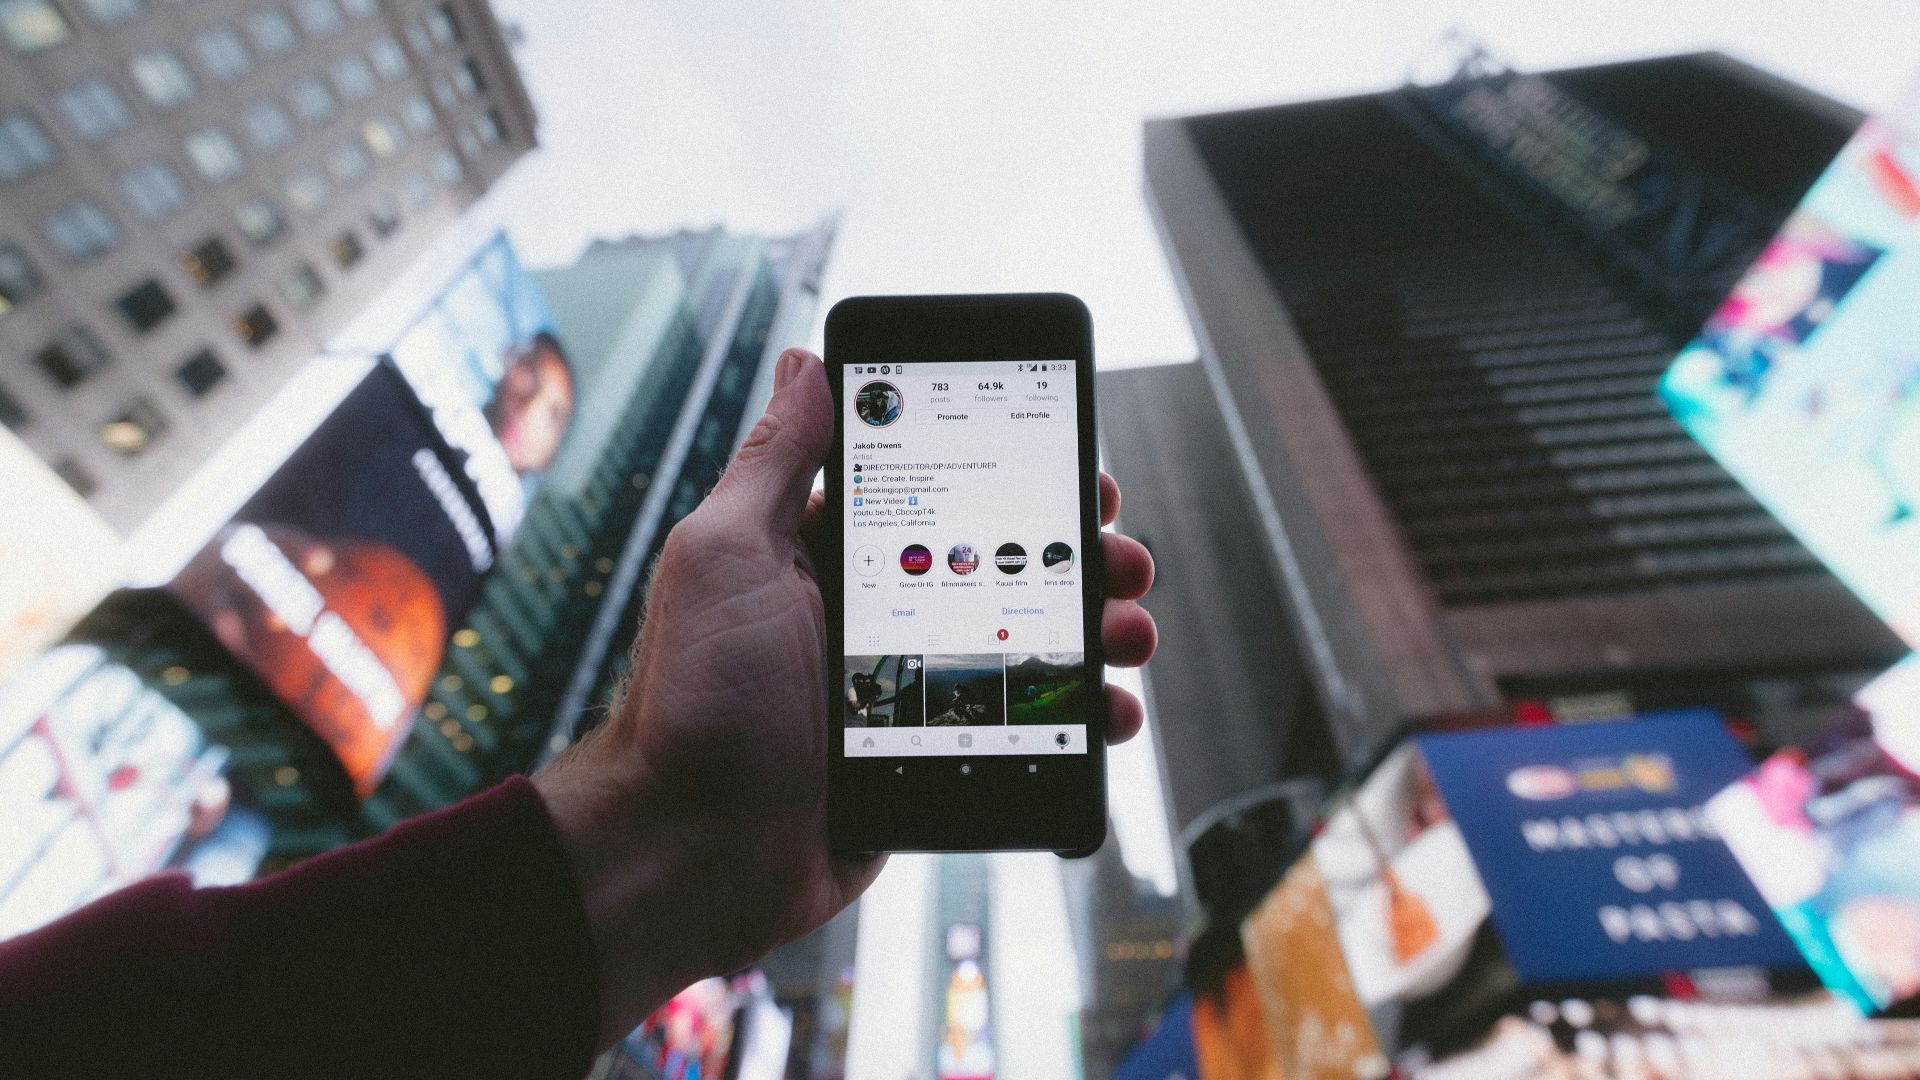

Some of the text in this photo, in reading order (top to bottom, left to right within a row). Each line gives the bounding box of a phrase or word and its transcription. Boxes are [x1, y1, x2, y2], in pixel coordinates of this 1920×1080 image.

[1051, 364, 1067, 372] 3:33
[931, 383, 949, 391] 783
[978, 382, 1004, 391] 64.9k
[1036, 381, 1048, 390] 19
[930, 395, 951, 403] posts
[974, 394, 1008, 402] followers
[1026, 394, 1058, 402] following
[1027, 411, 1050, 419] Profile
[863, 463, 997, 471] DIRECTOR/EDITOR/DP/ADVENTURER
[941, 580, 977, 588] filmmakers
[1060, 579, 1074, 587] drop
[892, 608, 915, 617] Email
[1002, 606, 1044, 615] Directions
[1596, 898, 1761, 945] PASTA
